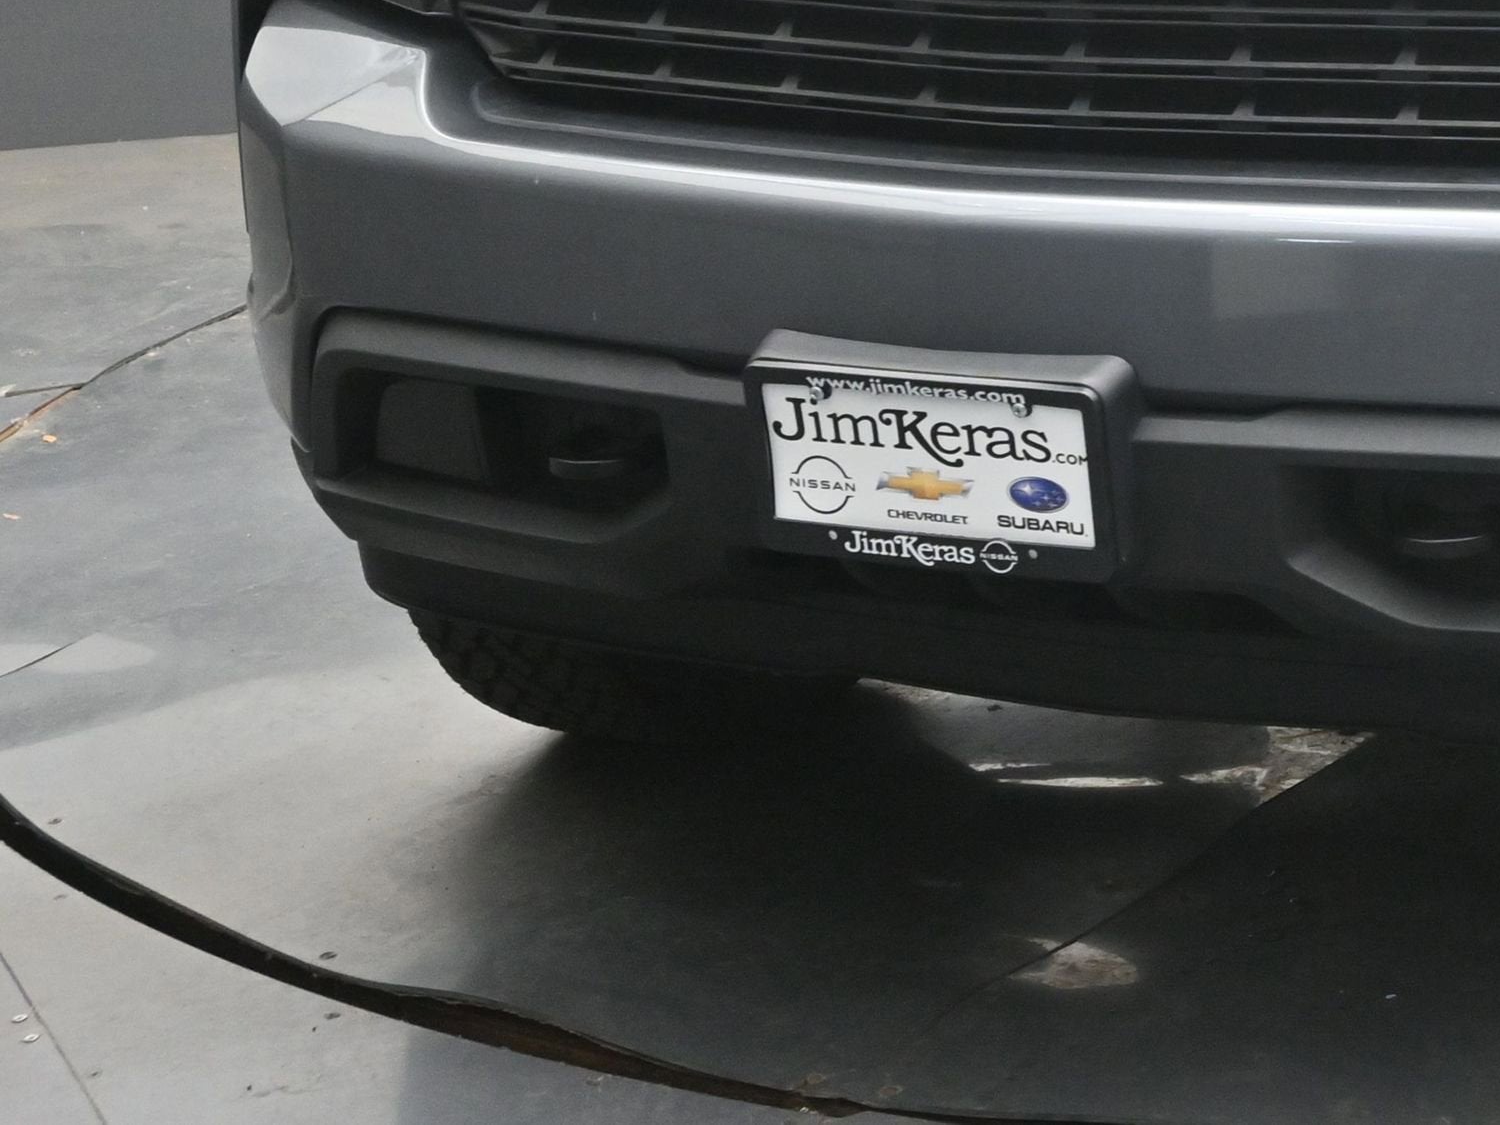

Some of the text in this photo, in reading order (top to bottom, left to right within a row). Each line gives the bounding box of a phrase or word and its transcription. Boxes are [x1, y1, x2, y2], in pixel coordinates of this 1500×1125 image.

[806, 376, 1026, 404] www.jimkeras.com
[789, 477, 856, 492] NISSAN
[887, 508, 968, 525] CHEVROLET
[997, 514, 1085, 535] SUBARU
[844, 530, 976, 566] JimKeras
[980, 551, 1019, 561] NISSAN
